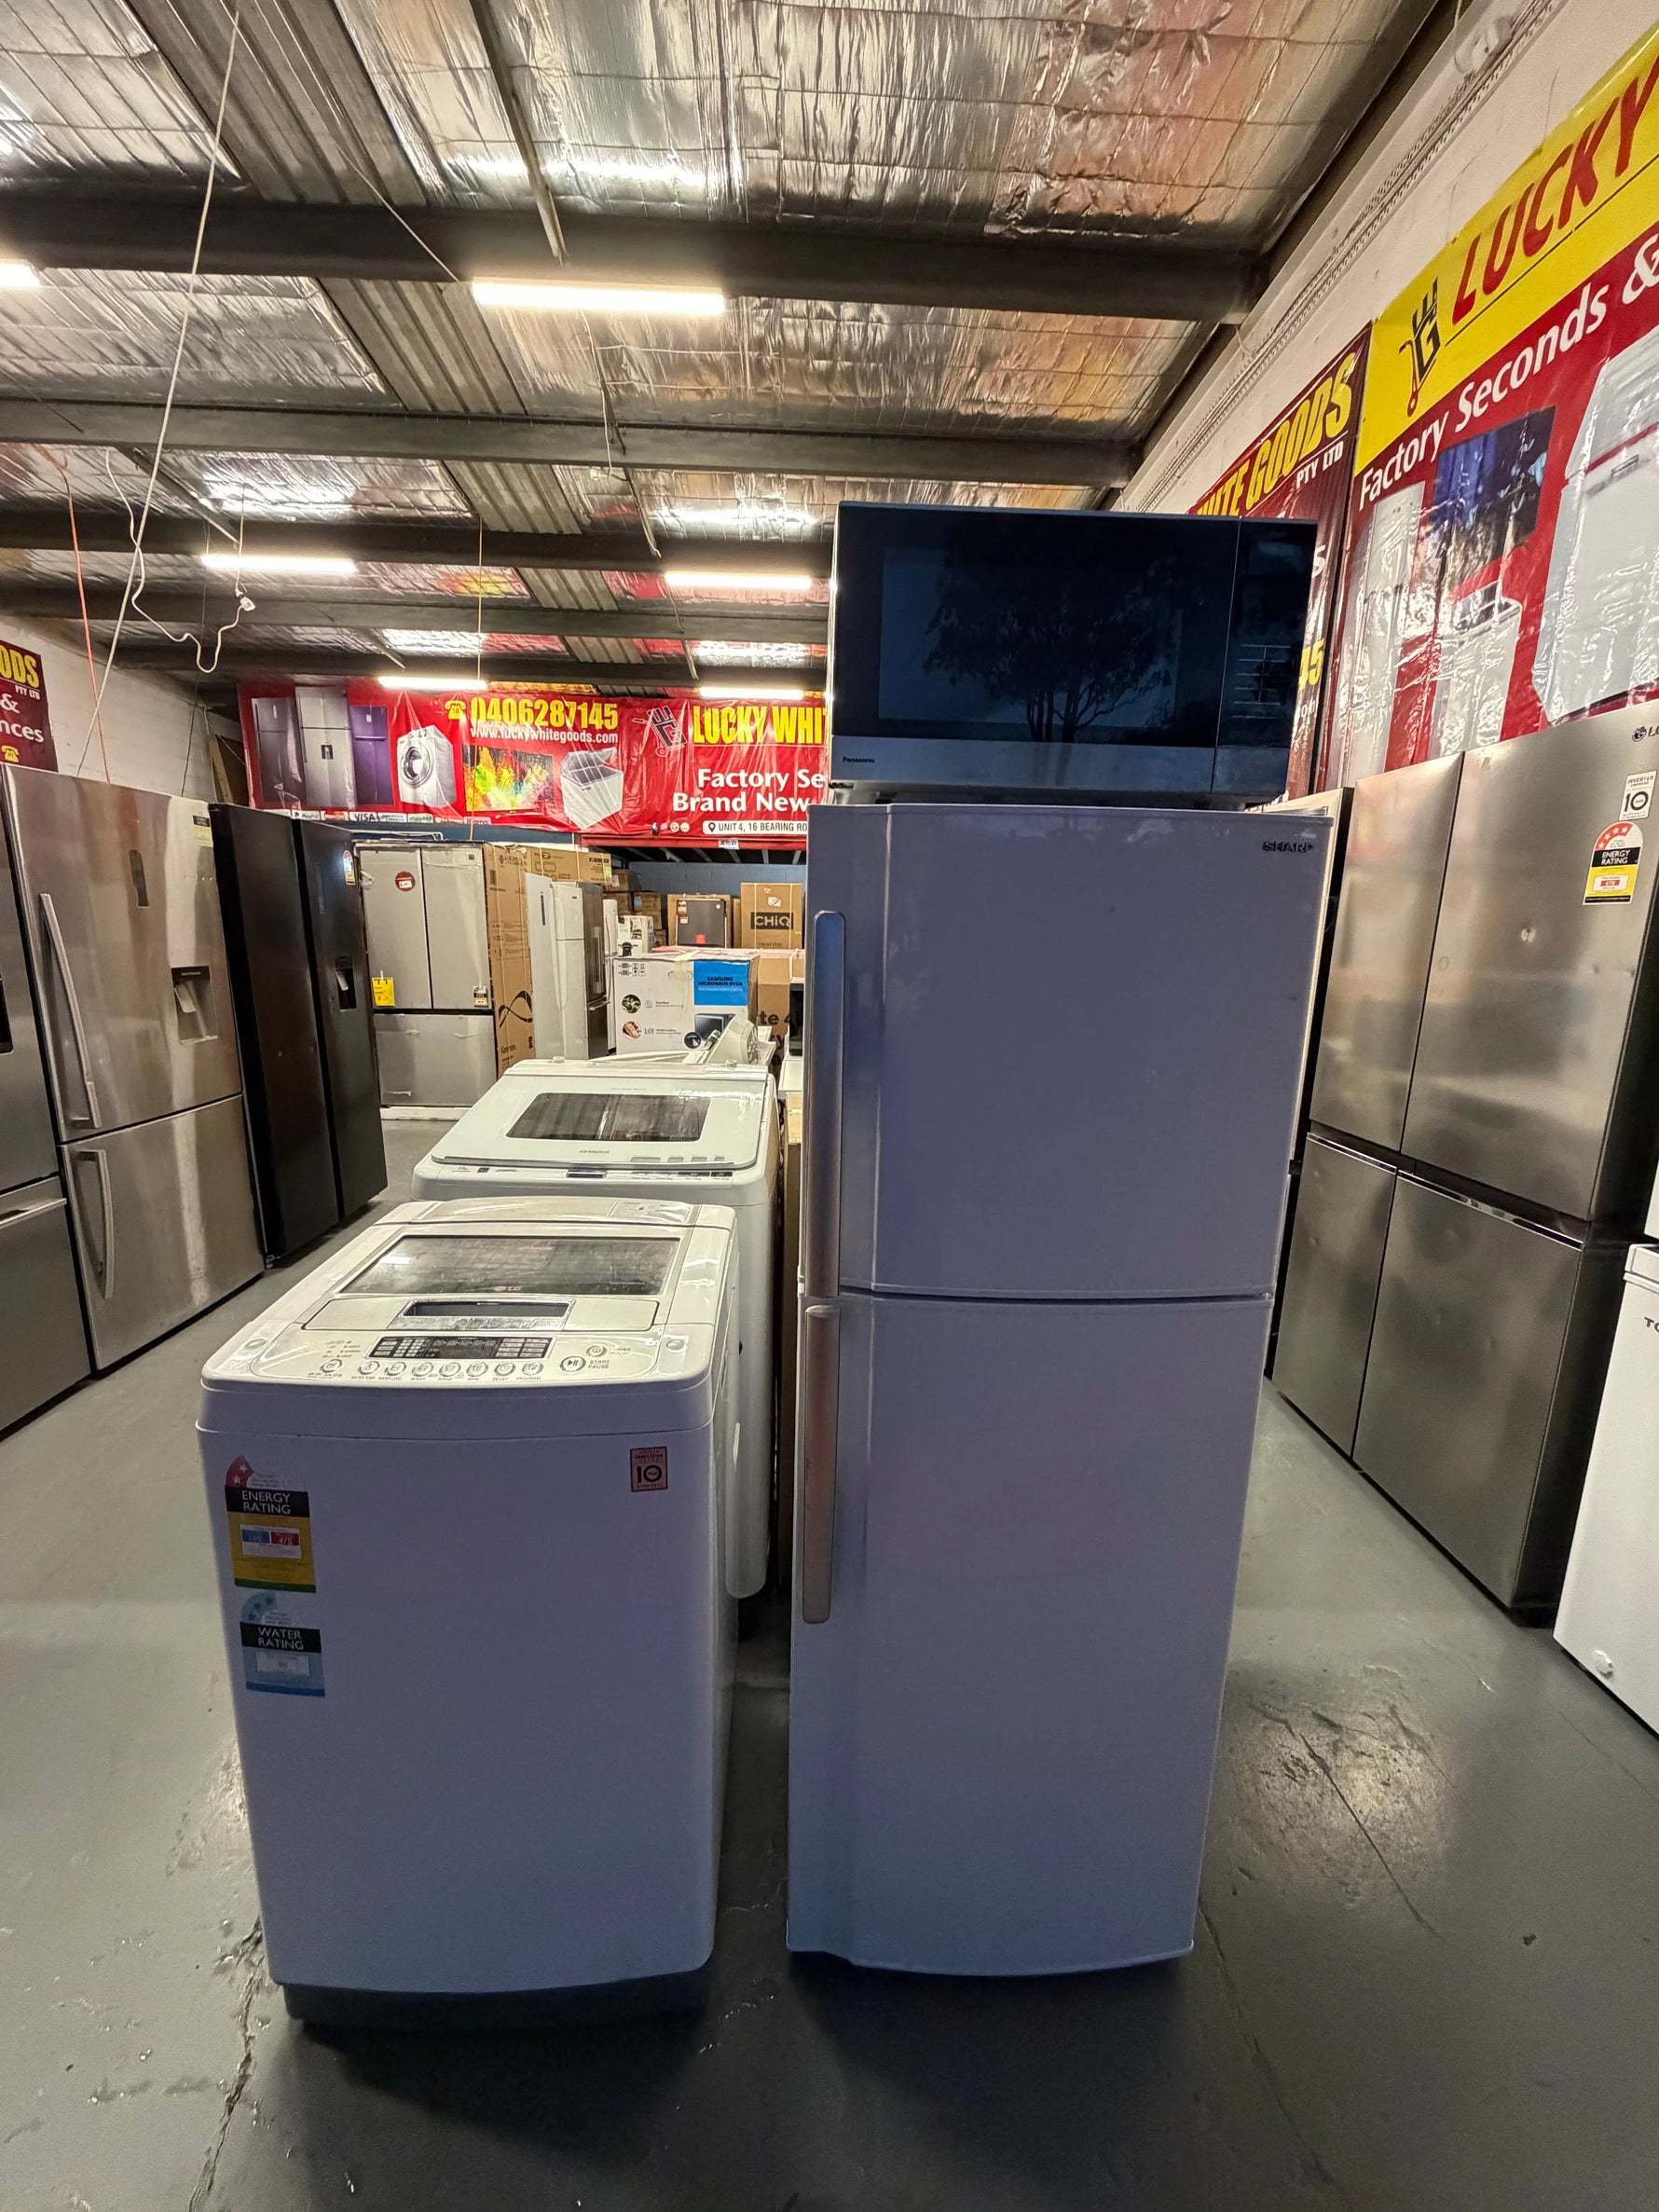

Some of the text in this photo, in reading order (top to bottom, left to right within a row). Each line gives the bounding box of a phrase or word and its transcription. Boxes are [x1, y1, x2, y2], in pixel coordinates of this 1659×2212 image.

[1451, 55, 1659, 327] LUCKY
[1358, 409, 1449, 512] Factory
[1455, 284, 1613, 433] Seconds
[1245, 351, 1356, 512] GOODS
[1296, 440, 1344, 490] PTY LTD
[14, 683, 41, 701] PTY LTD
[0, 693, 21, 714] &
[470, 696, 619, 731] 0406287145
[692, 706, 768, 745] LUCKY
[470, 727, 619, 744] www.luckywhitegoods.com
[698, 767, 790, 792] Factory
[672, 790, 811, 813] Brand New
[1624, 790, 1650, 813] 10
[355, 813, 376, 821] VISA
[718, 822, 738, 832] UNIT
[747, 822, 759, 832] 16
[760, 822, 795, 832] BEARING
[1263, 841, 1314, 853] SHARP
[1601, 849, 1631, 859] ENERGY
[1600, 857, 1628, 866] RATING
[755, 915, 791, 927] CHiQ
[636, 1464, 663, 1484] 10
[241, 1490, 292, 1504] ENERGY
[242, 1502, 293, 1515] RATING
[257, 1626, 302, 1641] WATER
[257, 1636, 305, 1651] RATING
